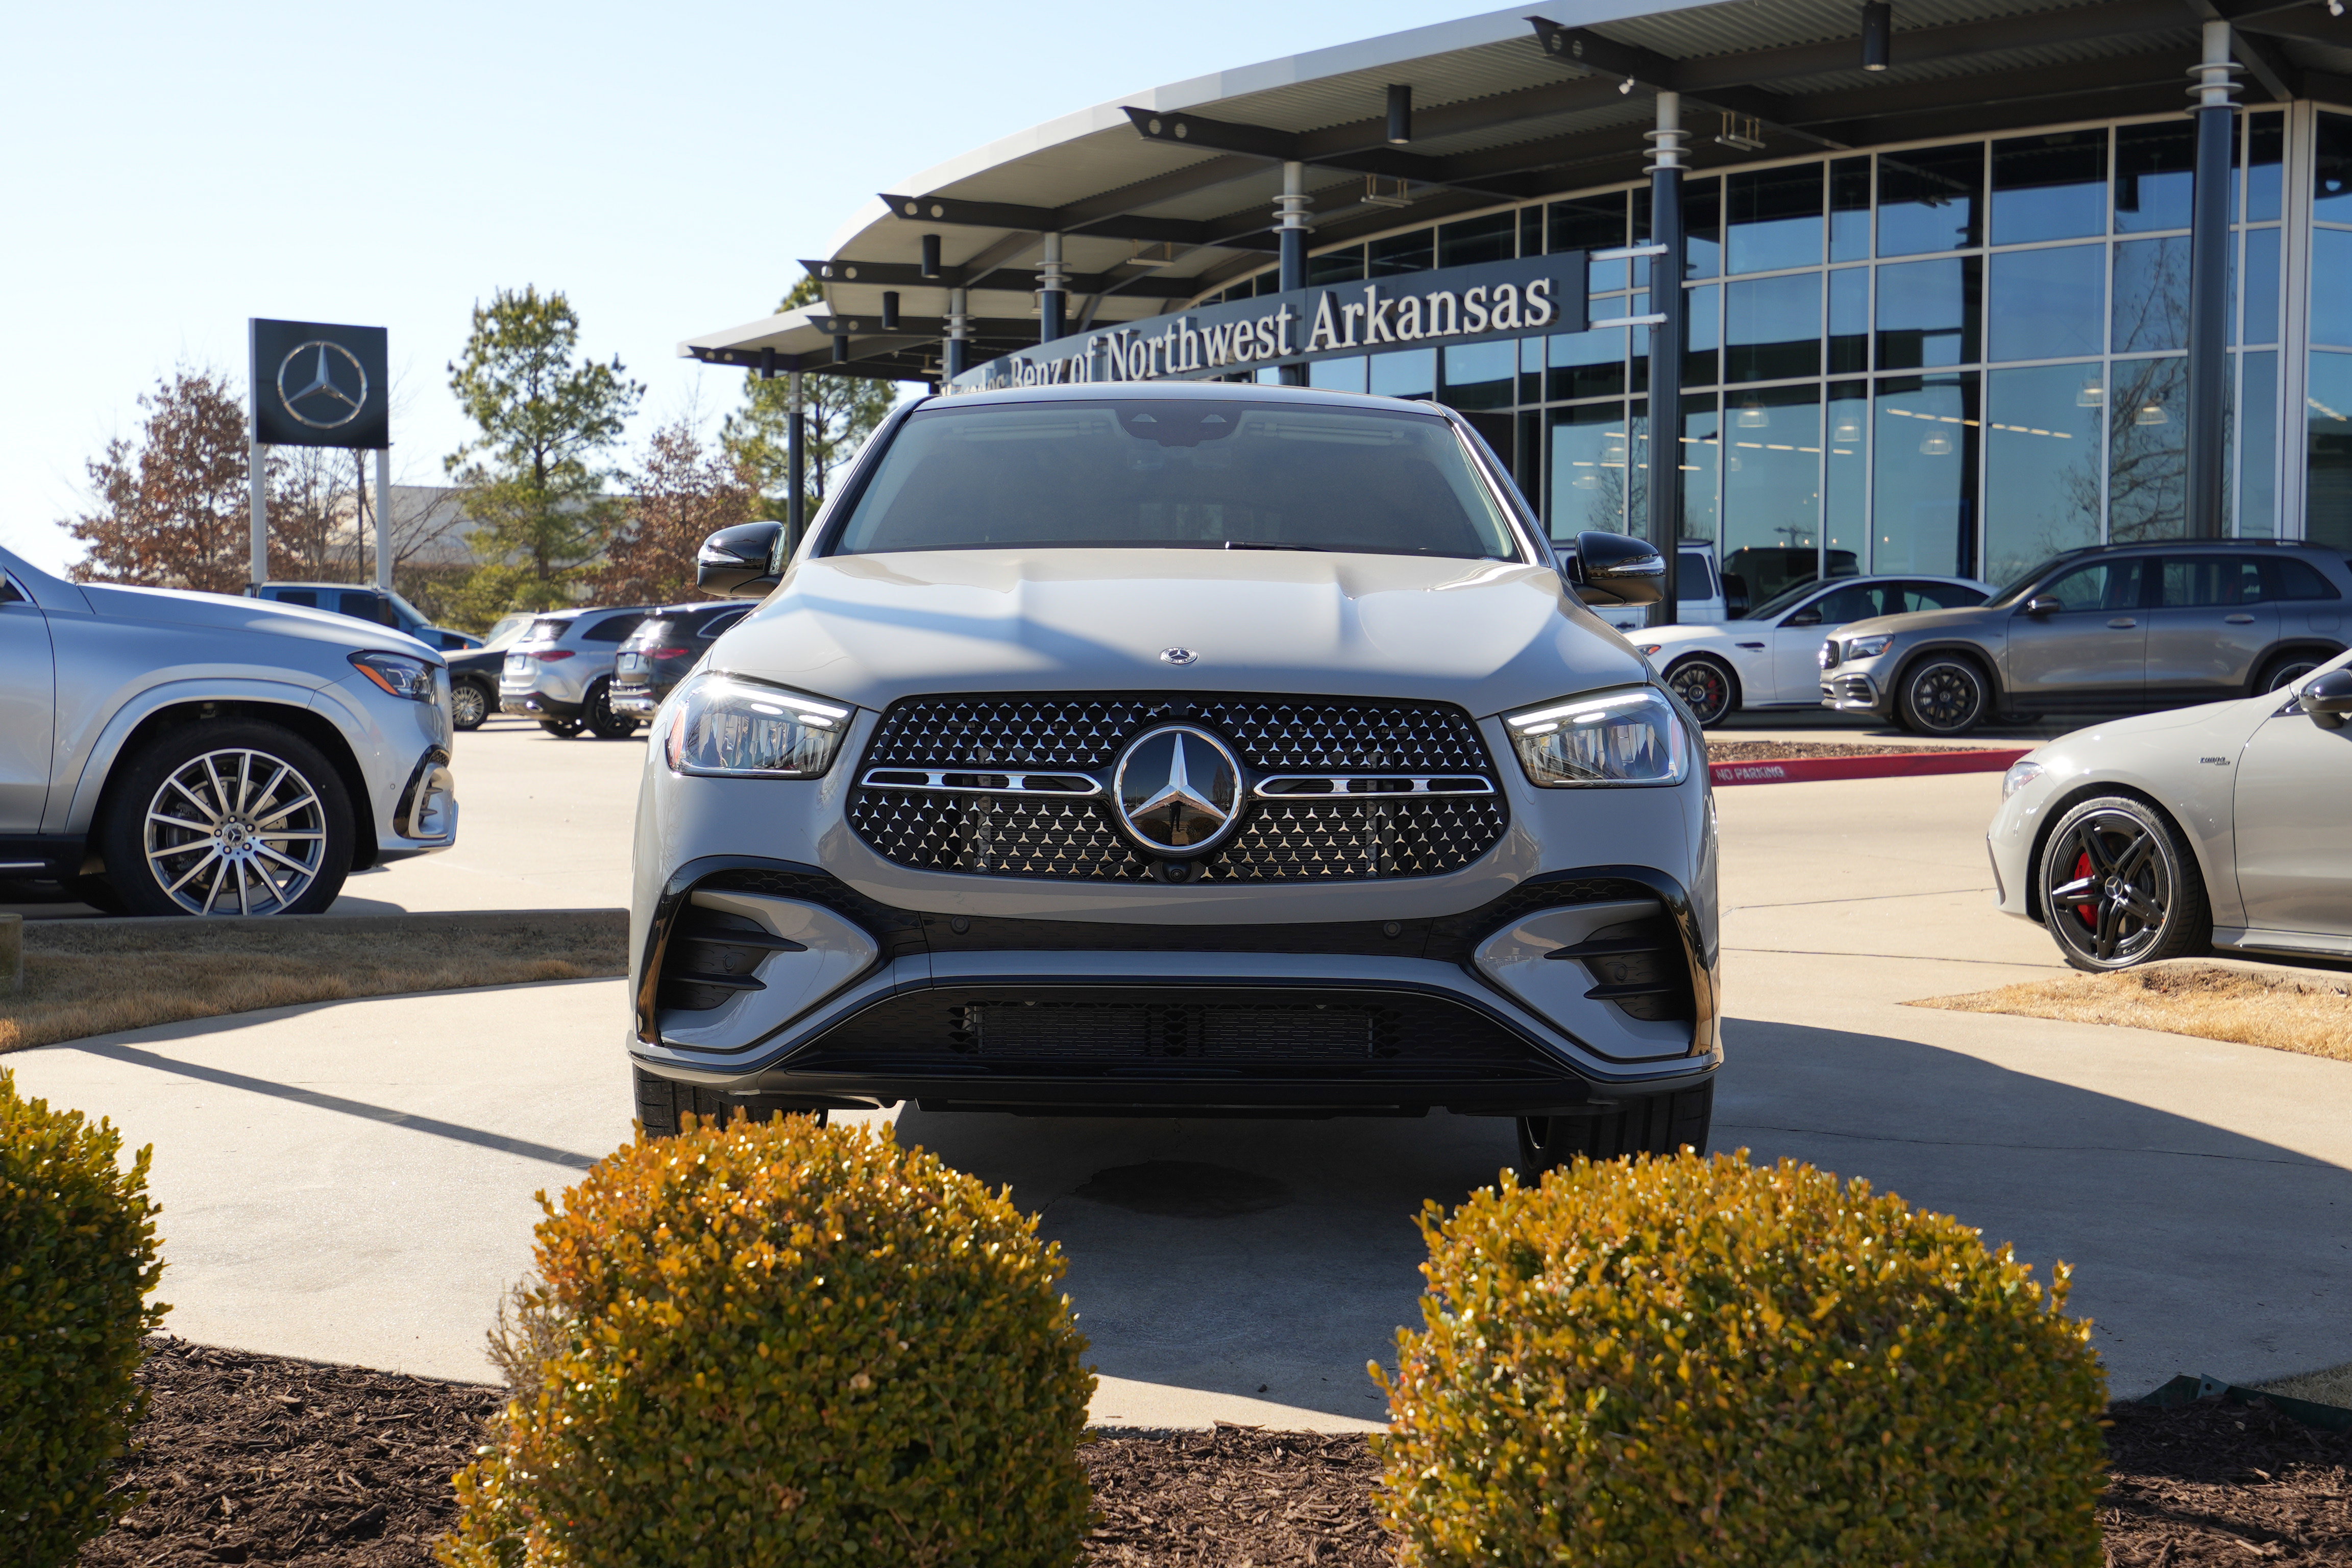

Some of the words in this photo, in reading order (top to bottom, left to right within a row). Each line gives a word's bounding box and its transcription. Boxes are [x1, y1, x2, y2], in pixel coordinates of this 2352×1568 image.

[1071, 335, 1097, 383] of
[1106, 303, 1292, 381] Northwest
[1305, 278, 1552, 352] Arkansas
[1716, 768, 1733, 781] NO
[1734, 766, 1785, 780] PARKING
